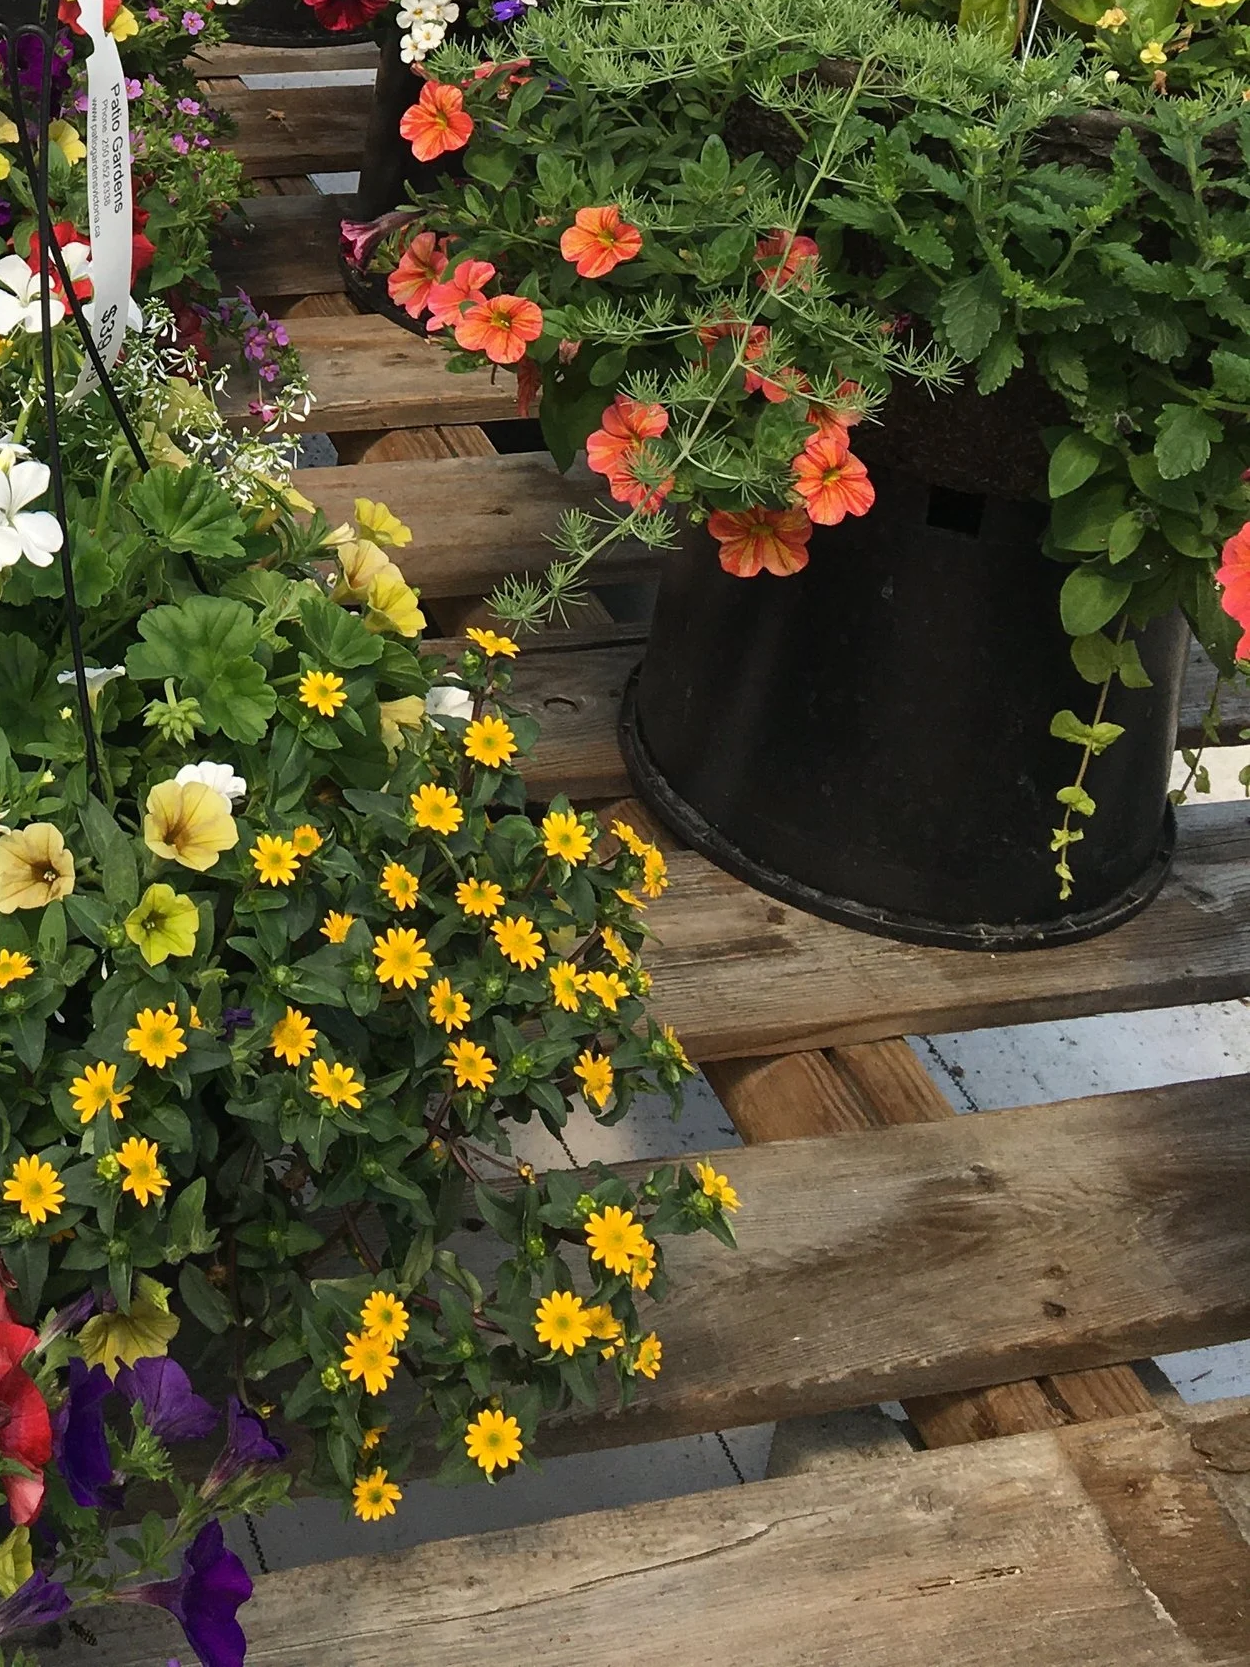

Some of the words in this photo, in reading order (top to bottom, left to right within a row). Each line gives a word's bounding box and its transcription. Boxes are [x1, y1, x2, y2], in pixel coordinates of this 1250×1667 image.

[110, 82, 123, 132] Patio
[102, 138, 110, 158] 250
[102, 159, 111, 180] 652
[111, 135, 124, 214] Gardens
